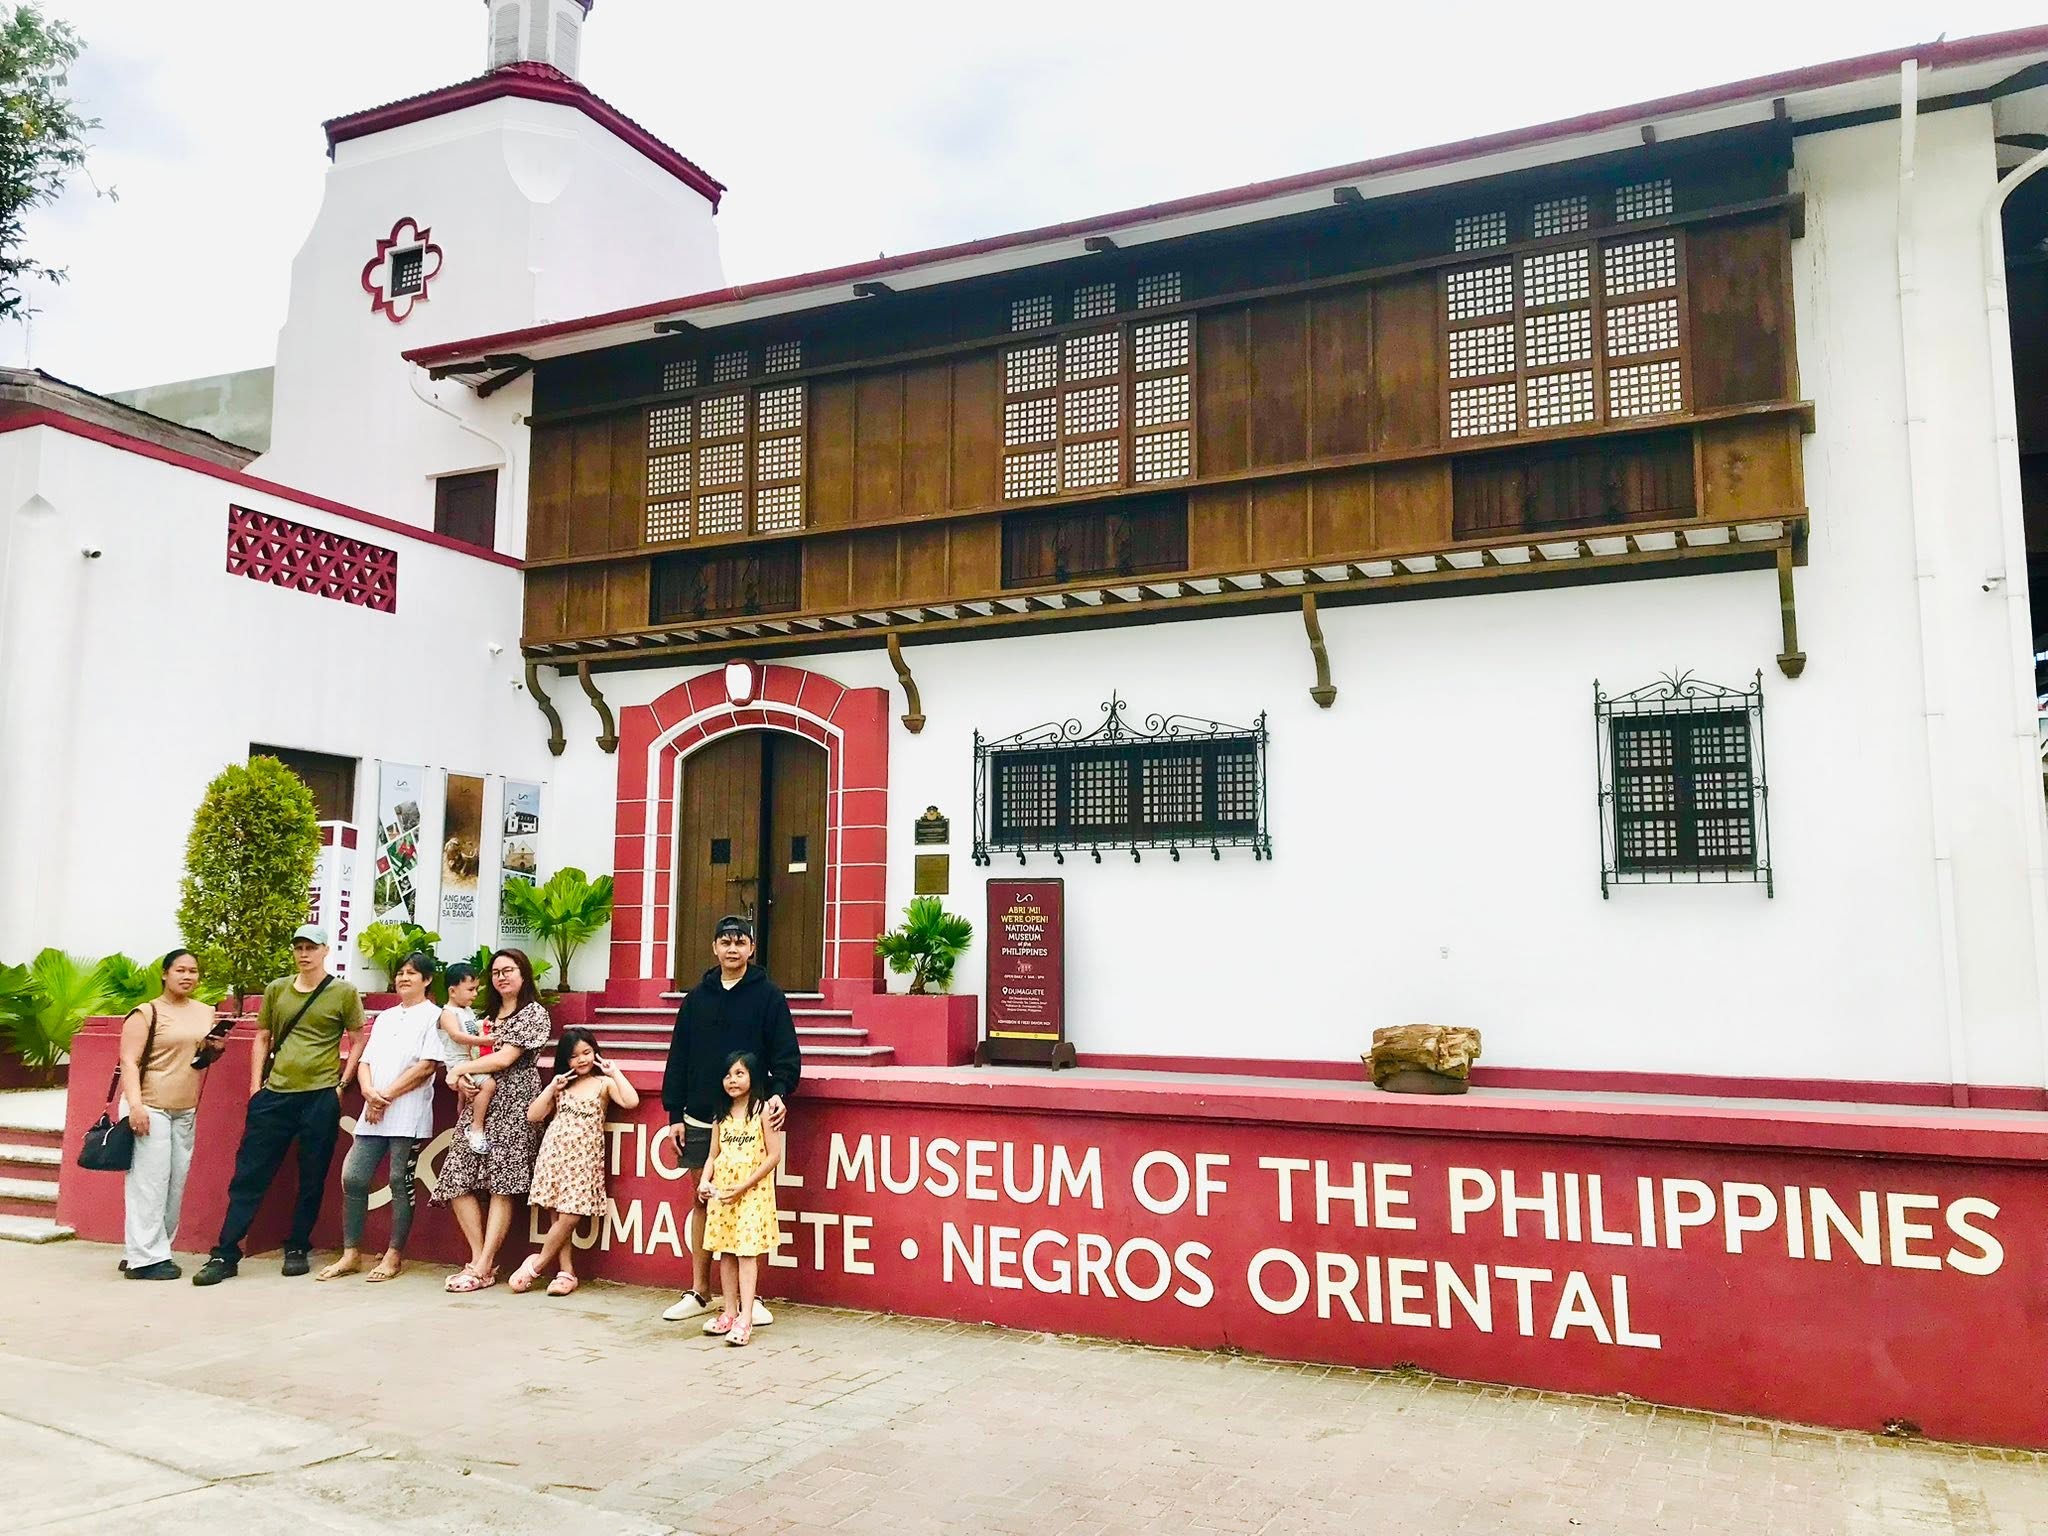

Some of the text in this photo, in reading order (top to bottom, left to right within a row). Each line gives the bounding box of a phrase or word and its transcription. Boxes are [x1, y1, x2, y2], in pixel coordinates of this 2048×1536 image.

[452, 910, 474, 918] BANGA
[1008, 906, 1026, 914] ABRI
[1001, 915, 1049, 923] WE'RE OPEN!
[1005, 924, 1044, 932] NATIONAL
[1008, 933, 1041, 941] MUSEUM
[1001, 948, 1048, 956] PHILIPPINES
[1008, 988, 1045, 996] DUMAGUETE
[721, 1131, 755, 1147] Siquijor
[826, 1131, 1105, 1209] MUSEUM
[1132, 1150, 1230, 1217] OF
[1258, 1156, 1417, 1230] THE
[1448, 1167, 2005, 1276] PHILIPPINES
[942, 1222, 1214, 1308] NEGROS
[1247, 1247, 1663, 1350] ORIENTAL
